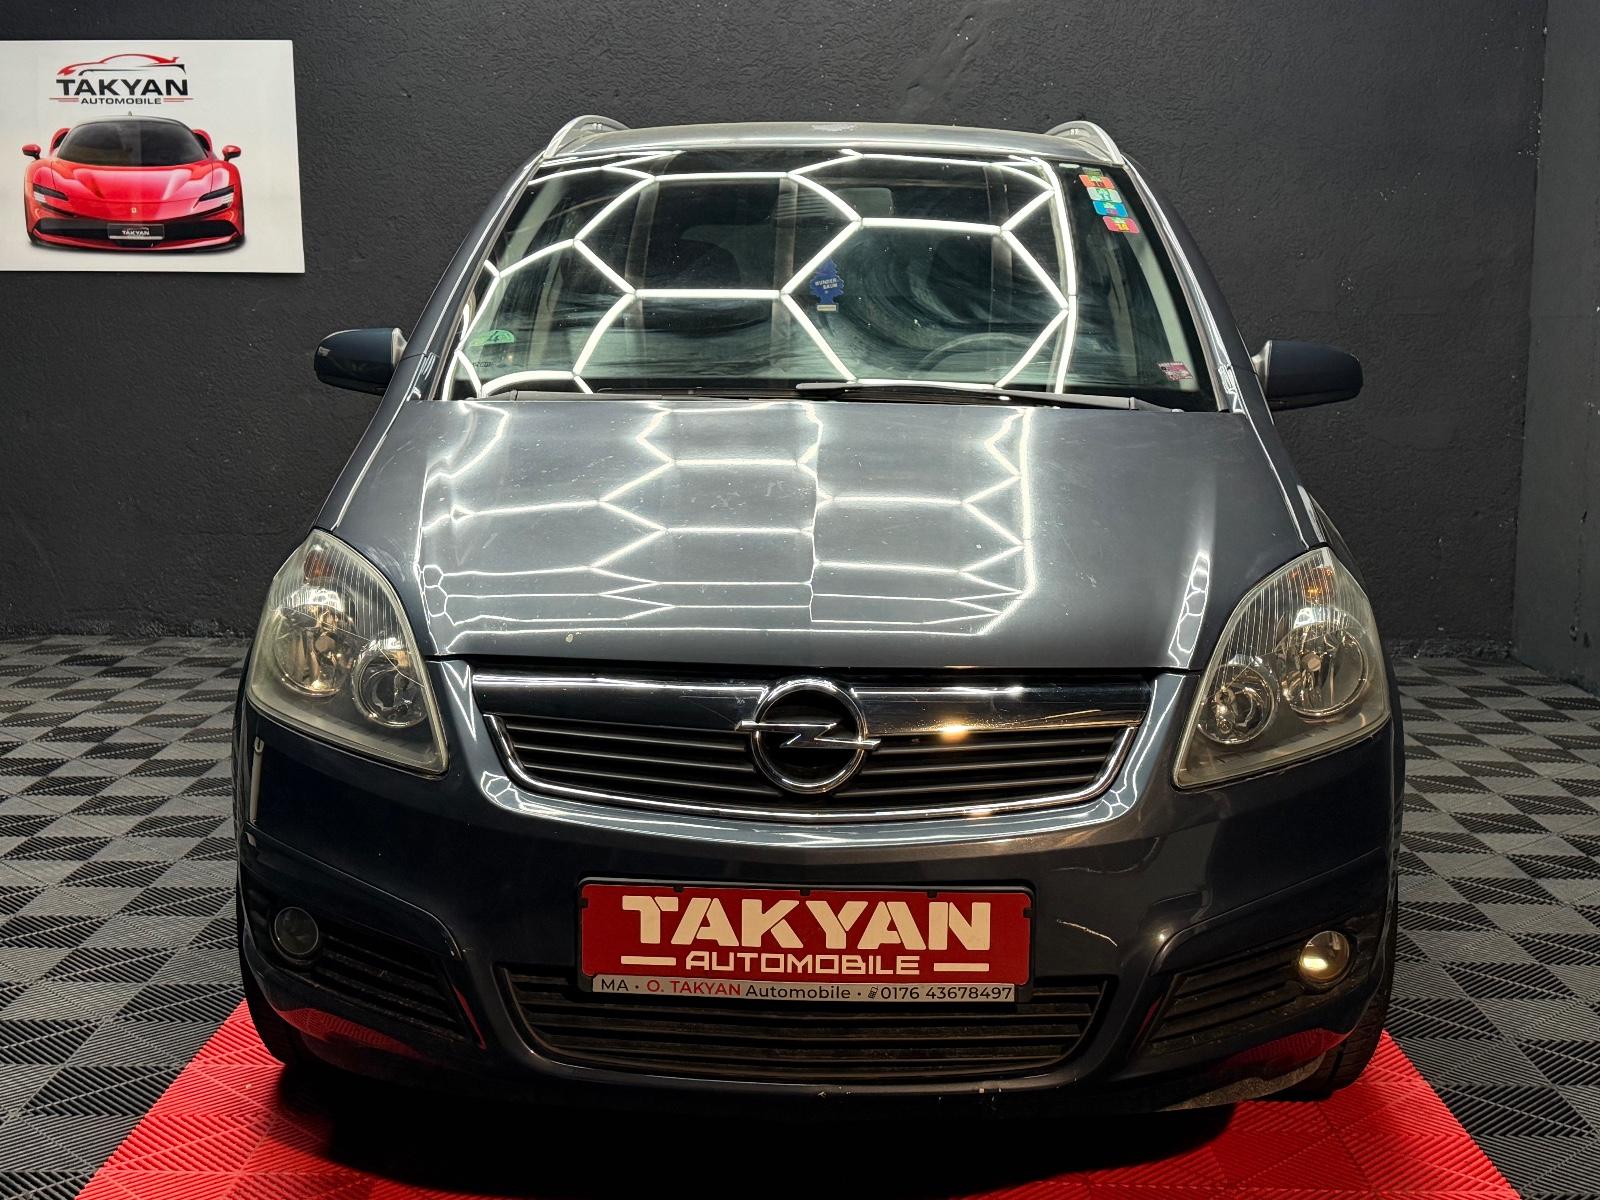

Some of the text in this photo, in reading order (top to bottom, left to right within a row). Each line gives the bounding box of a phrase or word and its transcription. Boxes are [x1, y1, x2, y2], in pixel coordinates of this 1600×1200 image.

[56, 78, 189, 96] TAKYAN
[80, 97, 162, 105] AUTOMOBILE
[621, 895, 991, 951] TAKYAN
[685, 950, 920, 975] AUTOMOBILE
[601, 978, 1013, 1000] MA O. TAKYAN Automobile 0176 43678497
